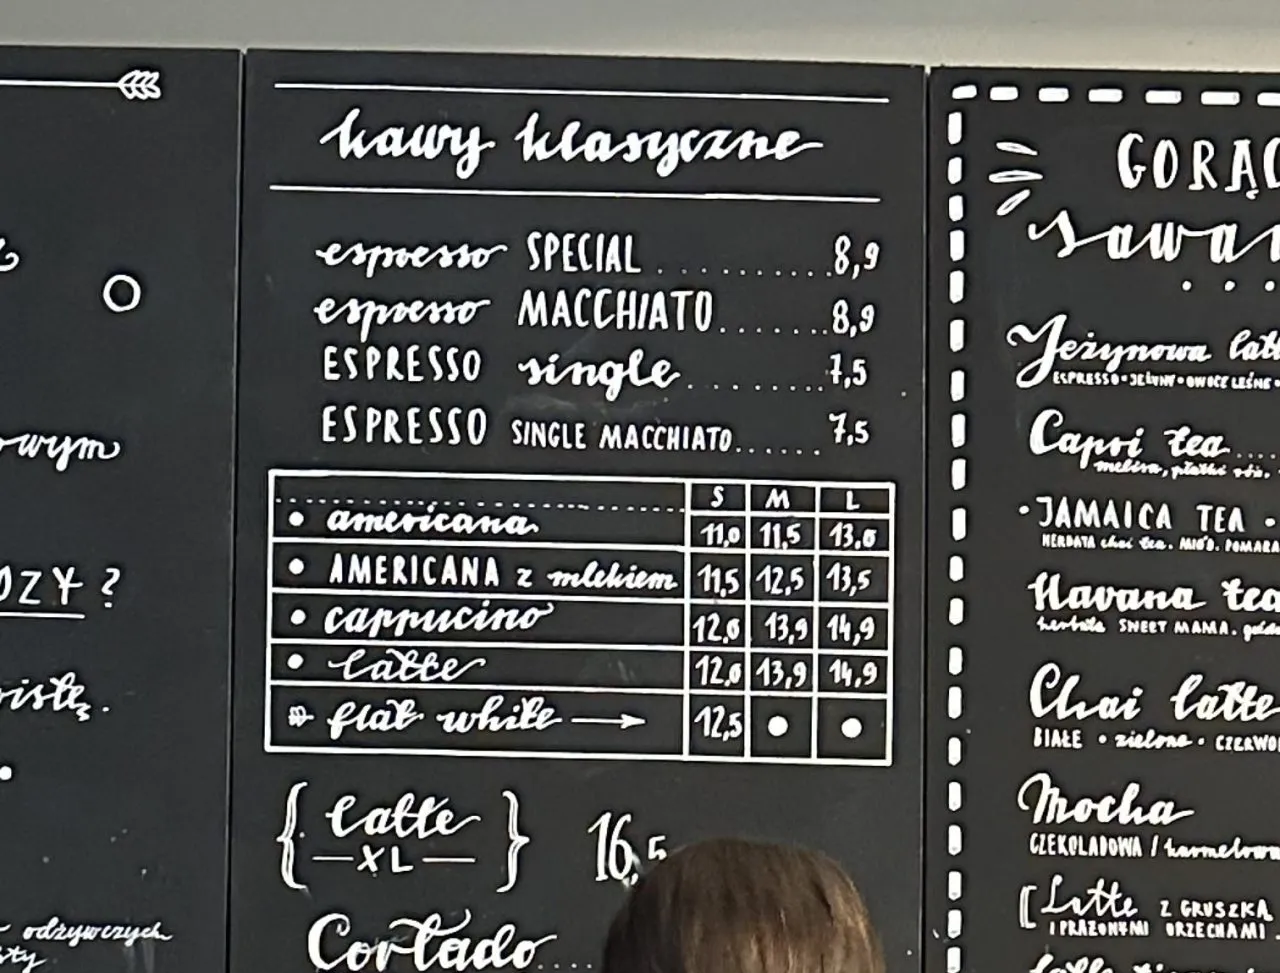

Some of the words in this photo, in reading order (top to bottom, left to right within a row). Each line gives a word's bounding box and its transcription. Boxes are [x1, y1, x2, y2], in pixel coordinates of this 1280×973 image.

[320, 109, 495, 179] kawy
[515, 113, 823, 177] klasyczne
[316, 243, 507, 277] espresso
[527, 232, 641, 272] SPECIAL
[835, 236, 879, 279] 8,9
[314, 298, 490, 342] espresso
[518, 288, 712, 331] MACCHIATO
[833, 300, 874, 337] 8,9
[325, 345, 480, 381] ESPRESSO
[518, 349, 680, 401] single
[830, 354, 866, 388] 7,5
[1007, 315, 1211, 388] Jeżynowa
[323, 406, 486, 445] ESPRESSO
[512, 420, 586, 449] SINGLE
[599, 425, 732, 451] MACCHIATO
[829, 413, 868, 445] 7,5
[1029, 409, 1144, 469] Capri
[1164, 426, 1230, 457] tea
[0, 434, 120, 471] wym
[711, 486, 724, 507] S
[765, 488, 789, 509] M
[847, 491, 859, 510] L
[1036, 497, 1171, 530] JAMAICA
[1197, 505, 1244, 532] TEA
[327, 504, 539, 535] americana
[700, 523, 741, 548] 11,0
[760, 522, 800, 546] 11,5
[1043, 533, 1095, 548] HERBATA
[330, 553, 499, 586] AMERICANA
[547, 561, 678, 590] mlekiem
[697, 564, 739, 597] 11,5
[756, 565, 803, 596] 12,5
[826, 563, 871, 596] 13,5
[1028, 572, 1206, 612] Havana
[325, 600, 554, 637] cappucino
[765, 612, 807, 645] 13,9
[827, 614, 874, 646] 14,9
[1119, 619, 1167, 633] SWEET
[328, 649, 486, 681] latte
[756, 658, 806, 689] 13,9
[829, 659, 877, 688] 14,9
[1030, 663, 1143, 720] Chai
[327, 700, 424, 739] flat
[436, 695, 562, 733] white
[694, 706, 742, 741] 12,5
[1034, 727, 1082, 748] BIAŁE
[1115, 729, 1192, 748] zielone
[1018, 773, 1194, 825] Mocha
[326, 793, 481, 838] latte
[588, 812, 667, 888] 16,5
[357, 845, 413, 872] XL
[1030, 833, 1142, 857] CZEKOLADOWA
[1041, 875, 1138, 917] Latte
[1160, 900, 1172, 917] Z
[1181, 899, 1273, 921] GRUSZKĄ
[23, 917, 172, 947] odżywczych
[308, 909, 558, 972] Cortado
[1166, 921, 1265, 939] ORZECHAMI
